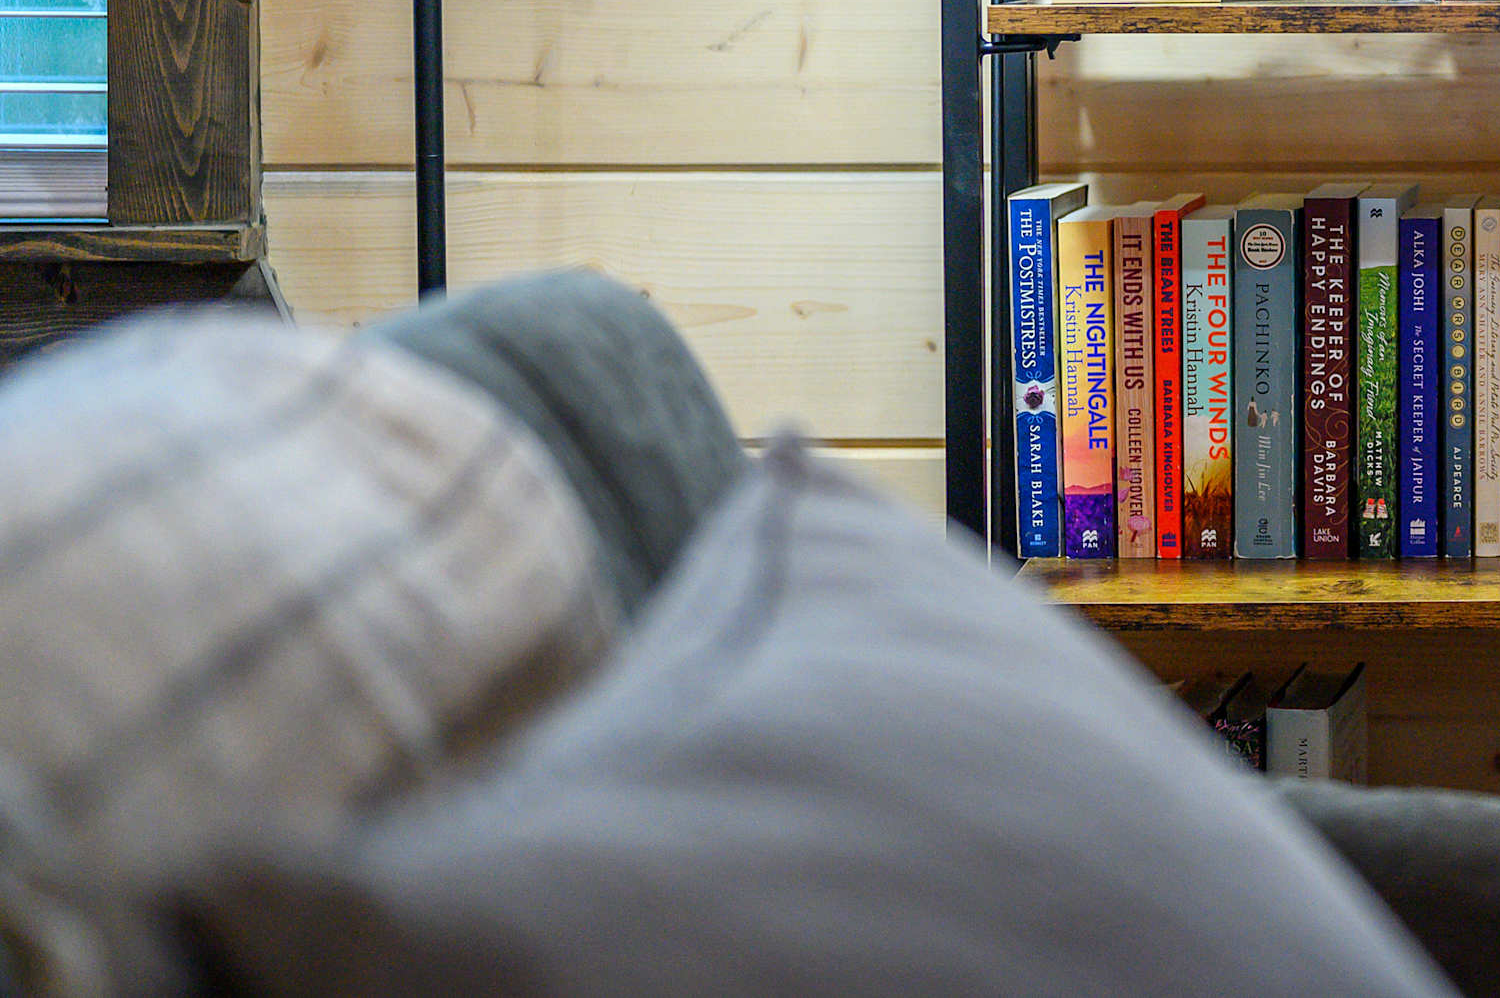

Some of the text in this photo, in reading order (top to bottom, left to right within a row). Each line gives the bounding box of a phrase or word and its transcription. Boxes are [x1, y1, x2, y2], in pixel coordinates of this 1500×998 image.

[1018, 209, 1037, 368] THE POSTMISTRESS
[1038, 307, 1046, 356] BESTSELLER
[1122, 234, 1145, 390] IT ENDS WITH US
[1160, 221, 1174, 353] THE BEAN TREES
[1255, 283, 1270, 395] PACHINKO
[1311, 217, 1326, 410] HAPPY ENDINGS
[1328, 225, 1343, 402] THE KEEPER OF
[1064, 285, 1083, 417] Kristin Hannah
[1084, 250, 1108, 449] THE NIGHTINGALE
[1185, 283, 1205, 417] Kristin Hannah
[1206, 237, 1228, 460] THE FOUR WINDS
[1029, 424, 1042, 473] SARAH
[1031, 481, 1044, 527] BLAKE
[1127, 408, 1143, 517] COLLEEN HOOVER
[1313, 454, 1325, 504] DAVIS
[1324, 440, 1338, 516] BARBARA
[1366, 442, 1374, 477] DICKS
[1298, 738, 1307, 778] MART
